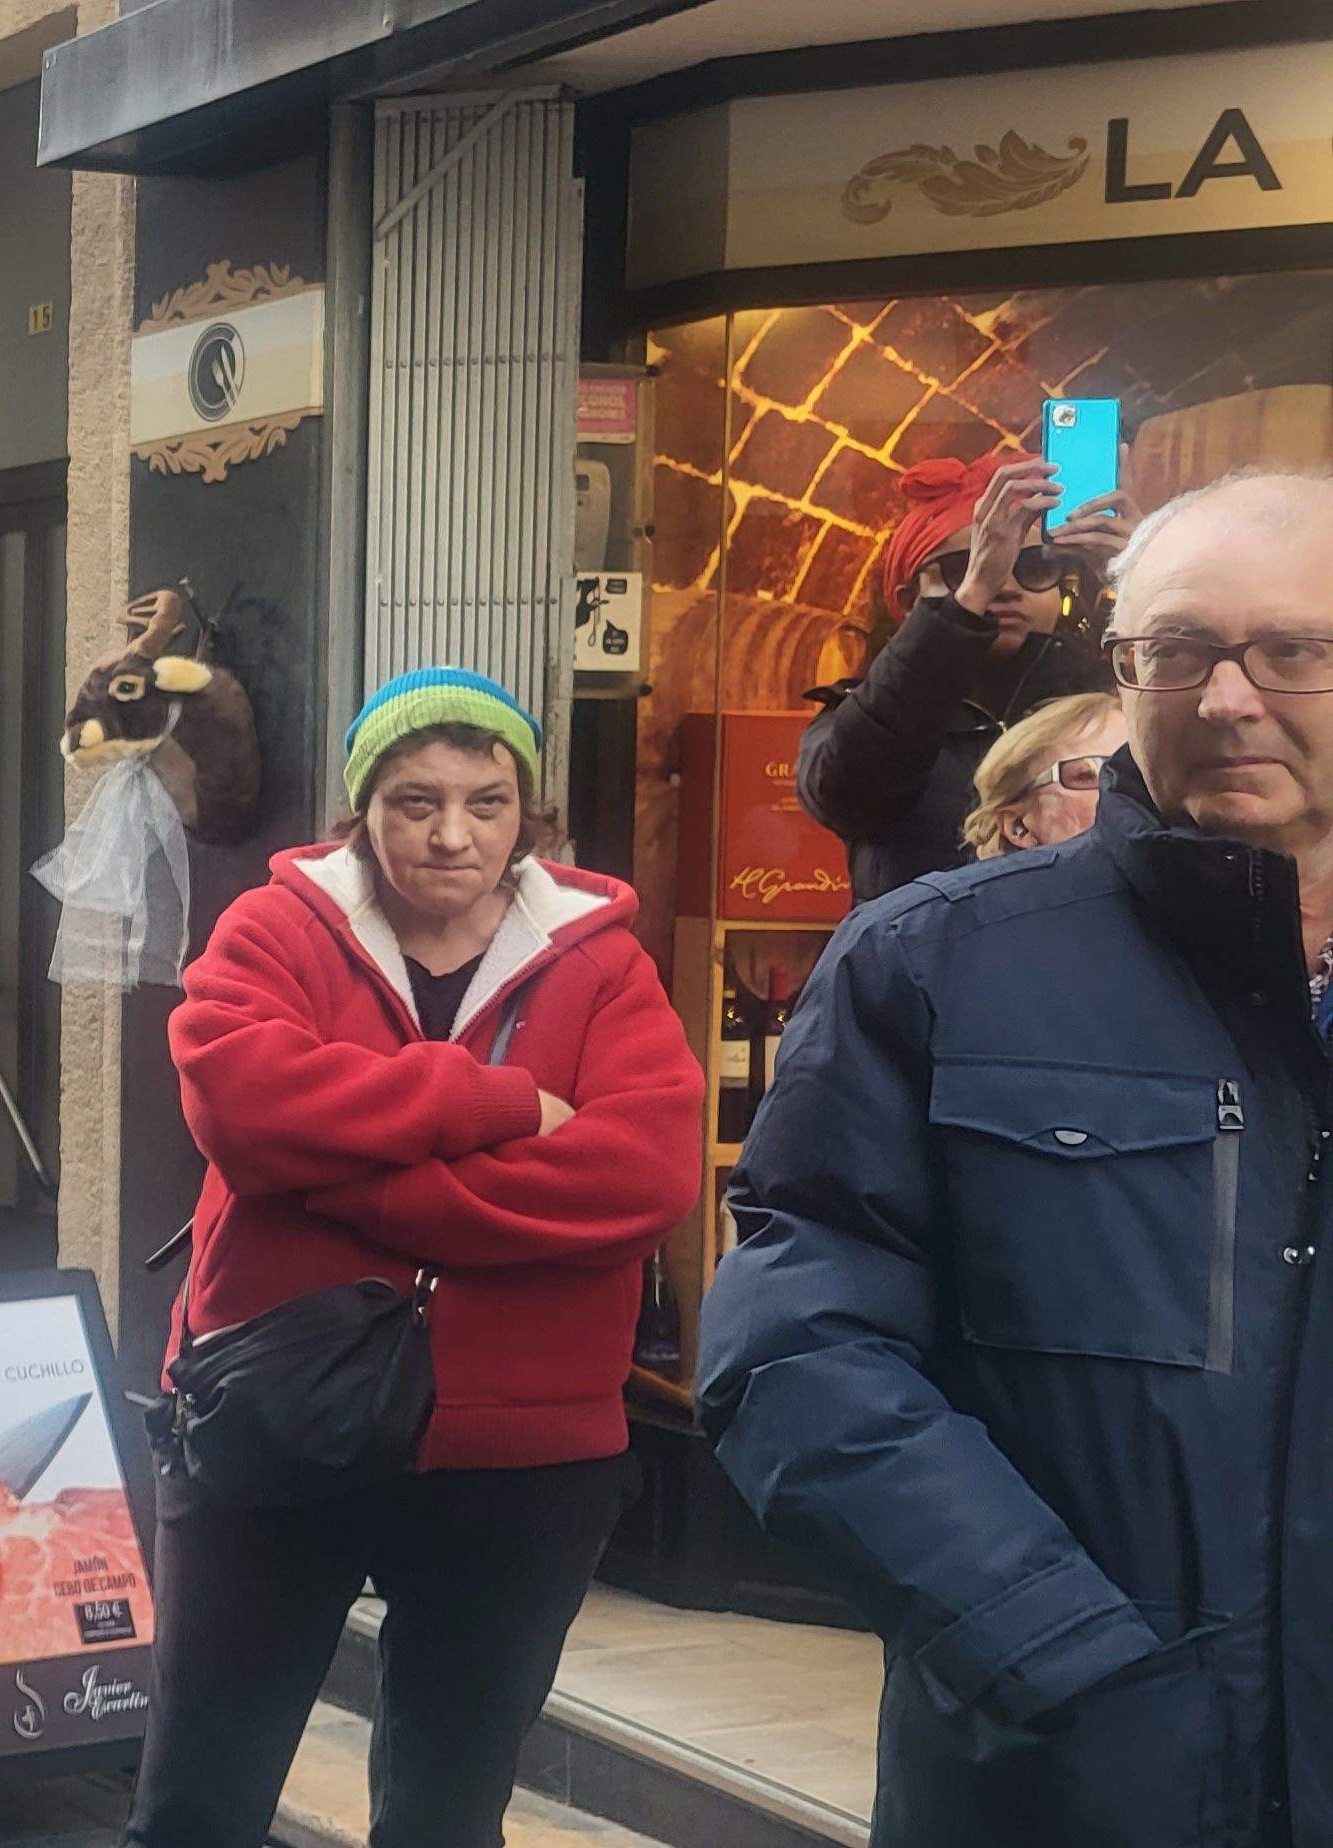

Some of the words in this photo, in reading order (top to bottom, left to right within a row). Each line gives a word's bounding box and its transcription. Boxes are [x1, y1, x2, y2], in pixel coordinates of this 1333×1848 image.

[1105, 108, 1282, 203] LA
[4, 1358, 85, 1381] CUCHILLO
[98, 1573, 136, 1591] CAMPO
